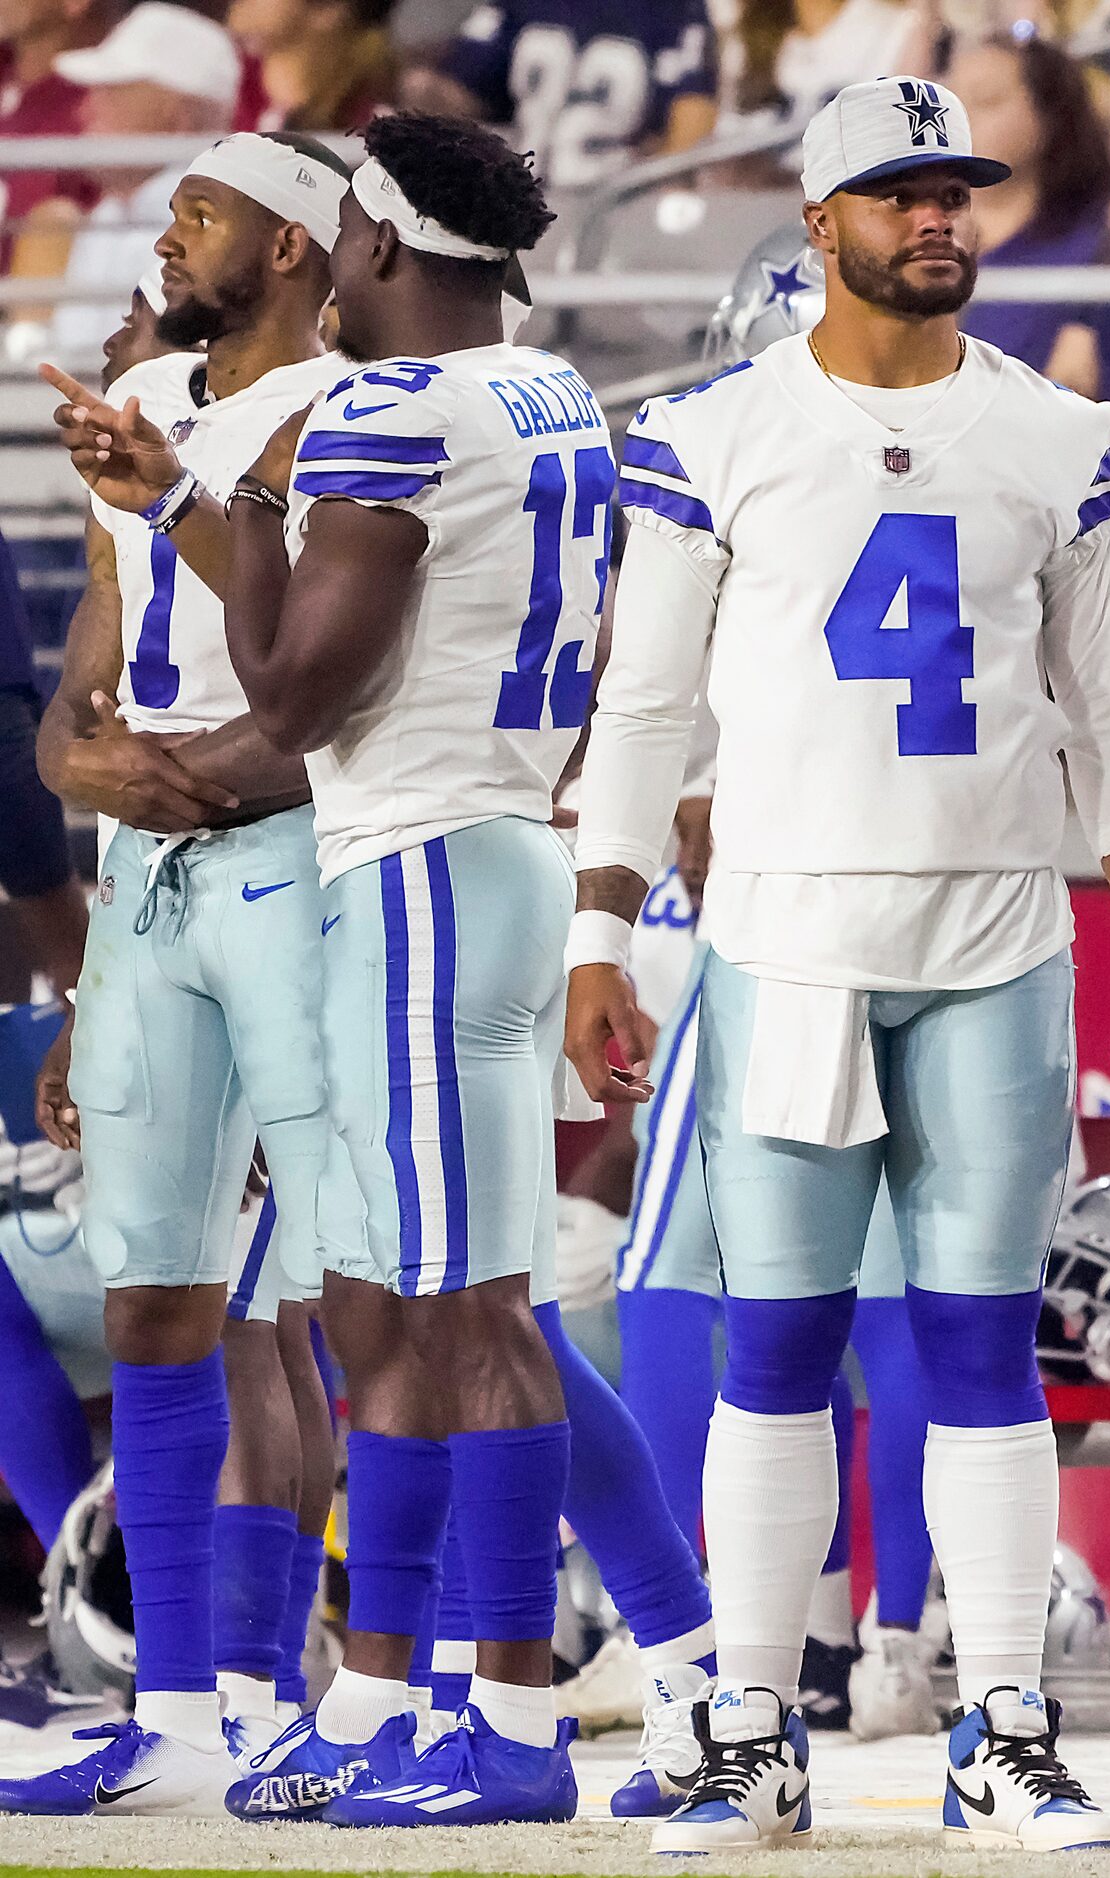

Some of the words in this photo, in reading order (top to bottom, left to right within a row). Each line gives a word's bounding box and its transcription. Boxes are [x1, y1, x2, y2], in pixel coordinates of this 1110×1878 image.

[488, 370, 602, 439] GALLUP
[492, 446, 616, 730] 13
[823, 513, 977, 756] 4
